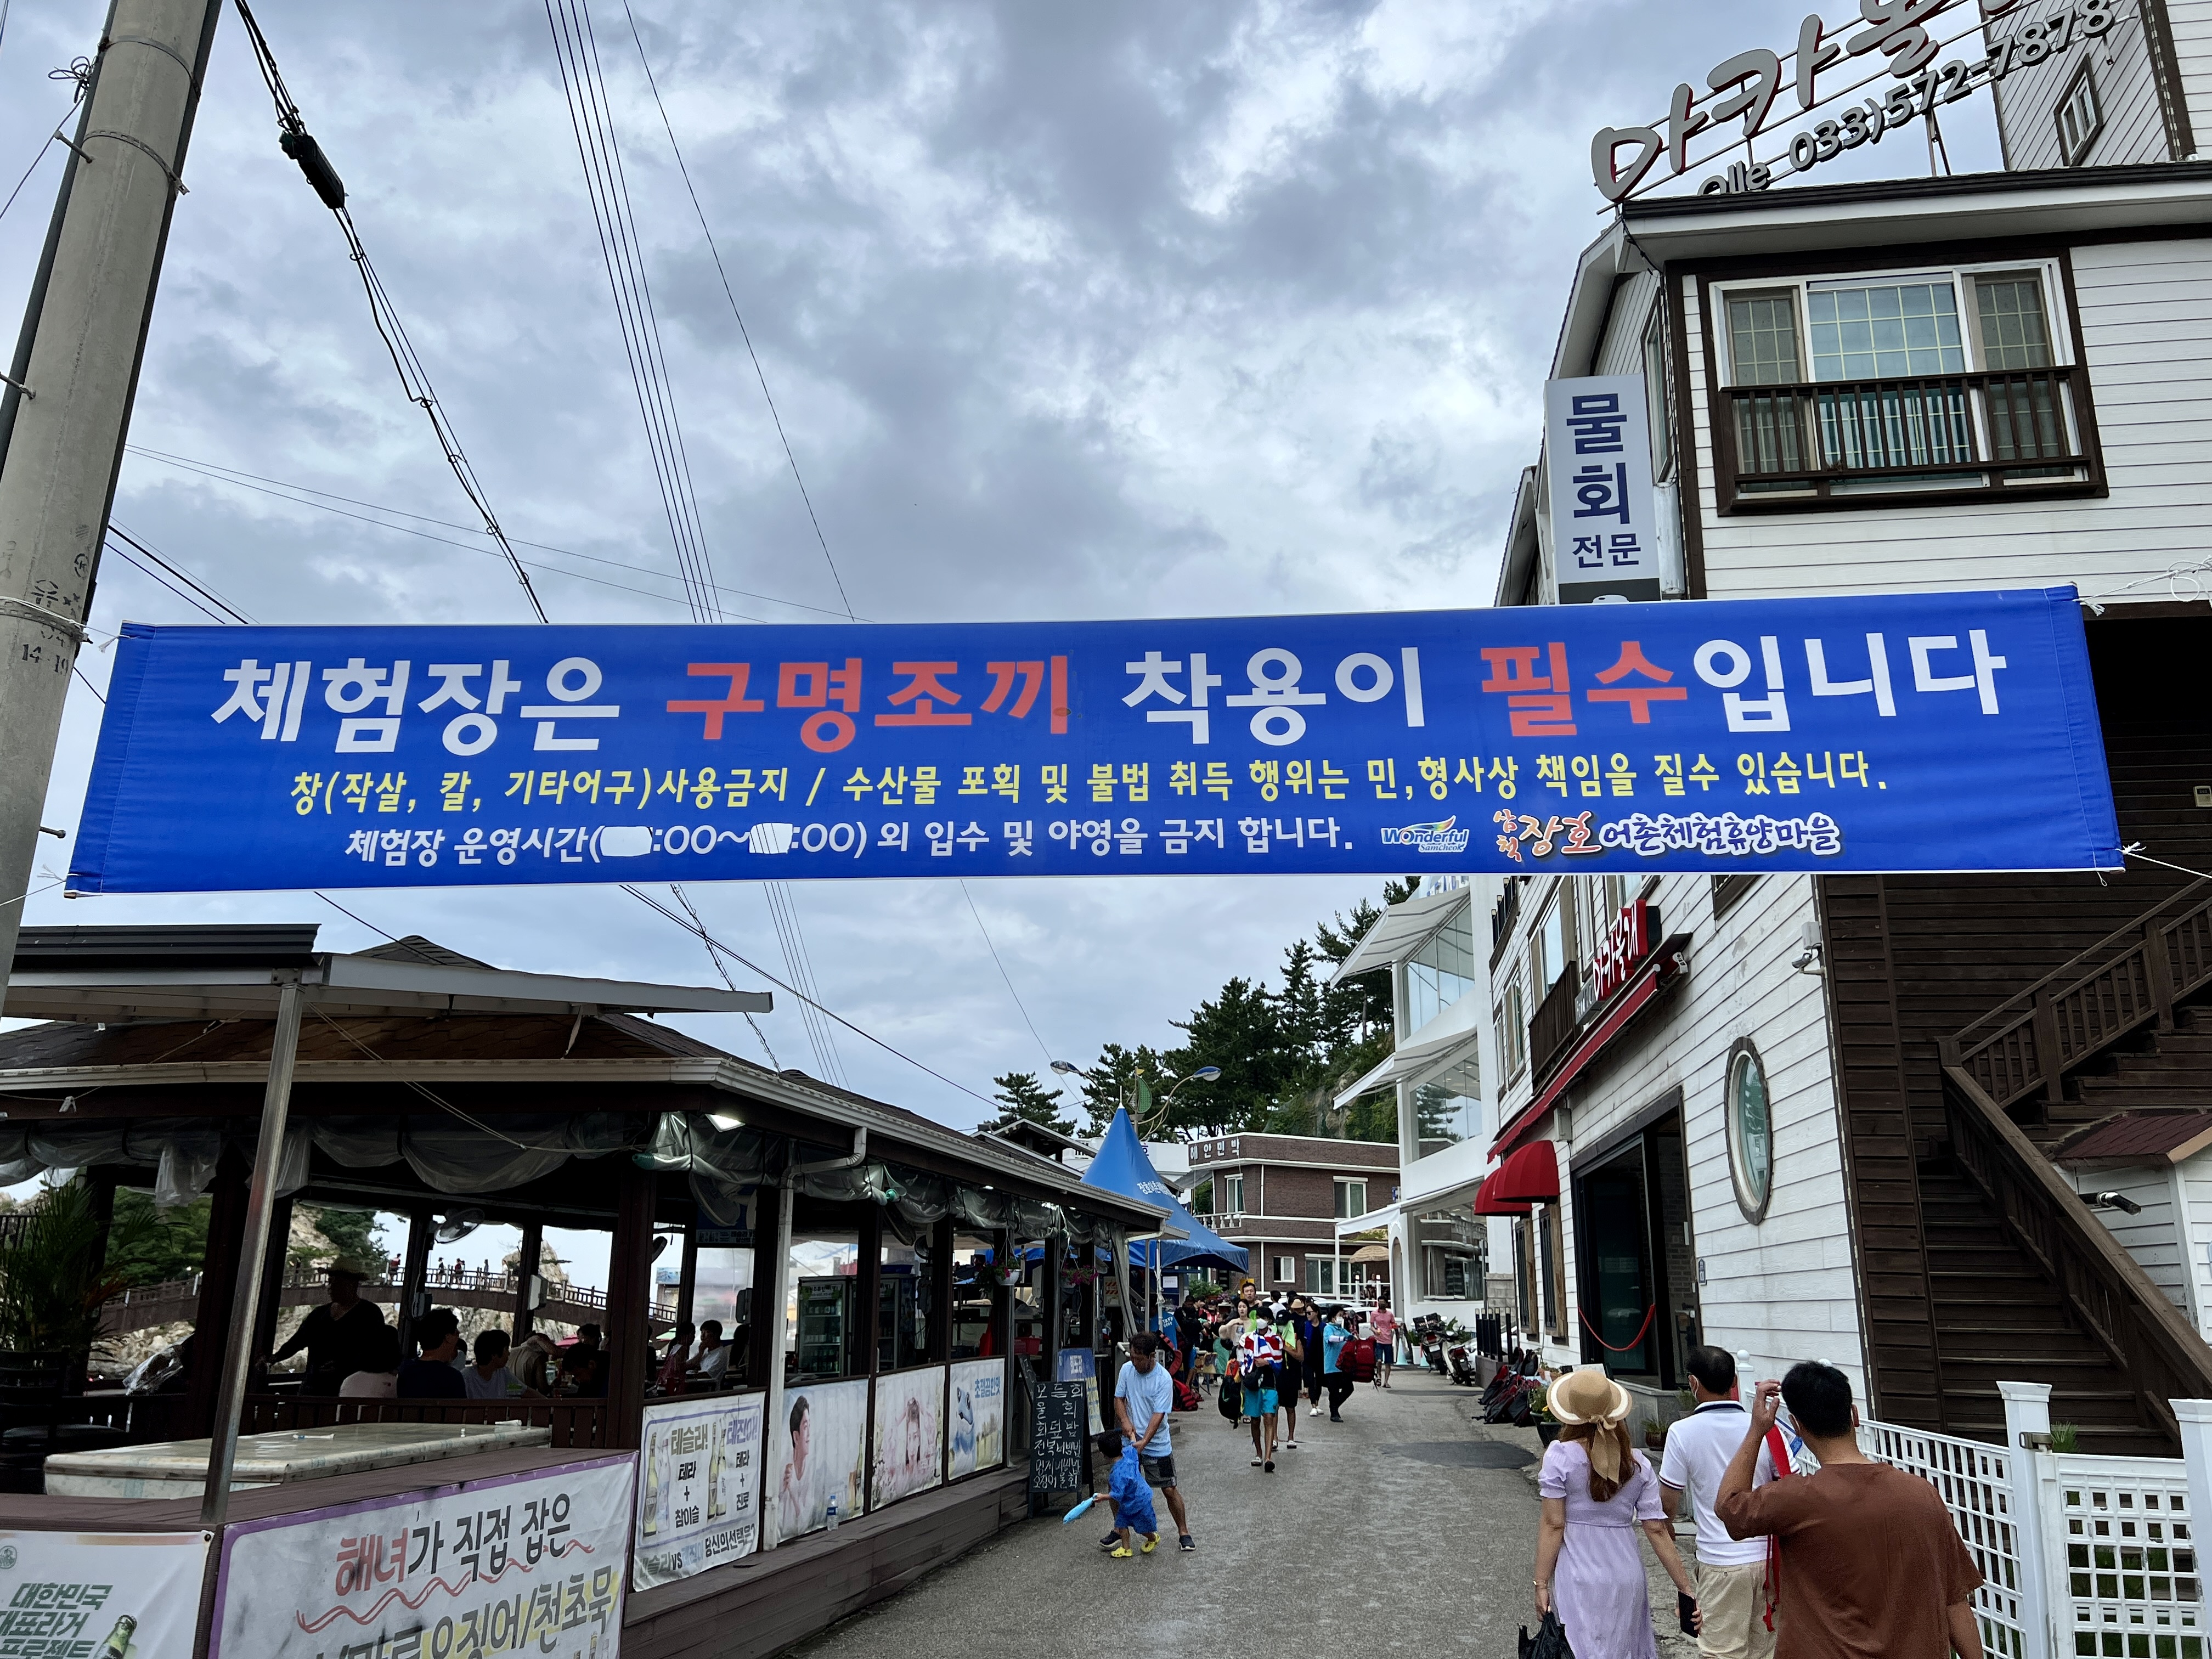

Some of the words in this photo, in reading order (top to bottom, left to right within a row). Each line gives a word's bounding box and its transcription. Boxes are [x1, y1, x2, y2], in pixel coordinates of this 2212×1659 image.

[1592, 0, 2016, 201] 마카올
[1788, 0, 2115, 171] 033)572-7878
[1566, 393, 1630, 524] 물회
[1572, 533, 1641, 568] 전문
[211, 658, 619, 755] 체험장은
[667, 657, 1067, 752] 구명조끼
[1122, 647, 1424, 746] 착용이
[1481, 630, 2006, 736] 필수입니다
[294, 774, 414, 814] 창(작살,
[443, 773, 480, 809] 칼,
[507, 769, 787, 808] 기타어구)사용금지
[808, 769, 823, 804] /
[845, 768, 939, 803] 수산물
[960, 765, 1019, 802] 포획
[1043, 765, 1066, 802] 및
[1088, 764, 1148, 800] 불법
[1171, 763, 1231, 799] 취득
[1251, 761, 1347, 800] 행위는
[1538, 754, 1635, 795] 책임을
[1657, 755, 1718, 794] 질수
[1739, 753, 1887, 792] 있습니다.
[345, 830, 445, 866] 체험장
[454, 822, 866, 865] 운영시간(:00~:00)
[878, 822, 908, 851] 외
[925, 822, 989, 856] 입수
[1005, 821, 1032, 856] 및
[1049, 818, 1148, 856] 야영을
[1160, 819, 1223, 853] 금지
[1238, 817, 1352, 853] 합니다.
[1383, 828, 1468, 844] Wonderful
[1420, 843, 1463, 852] Samcheok
[1494, 810, 1521, 861] 삼척
[1519, 811, 1601, 855] 장호
[1602, 815, 1836, 852] 어촌체험휴양마을
[1190, 1139, 1240, 1160] 해안민박
[671, 1424, 708, 1455] 테슬라!
[678, 1461, 696, 1481] 테라
[736, 1450, 749, 1468] 테라
[675, 1506, 699, 1528] 참이슬
[736, 1492, 749, 1510] 진로
[336, 1521, 443, 1596] 해녀가
[453, 1505, 511, 1582] 직접
[521, 1493, 570, 1565] 잡은
[9, 1582, 114, 1610] 대한민국
